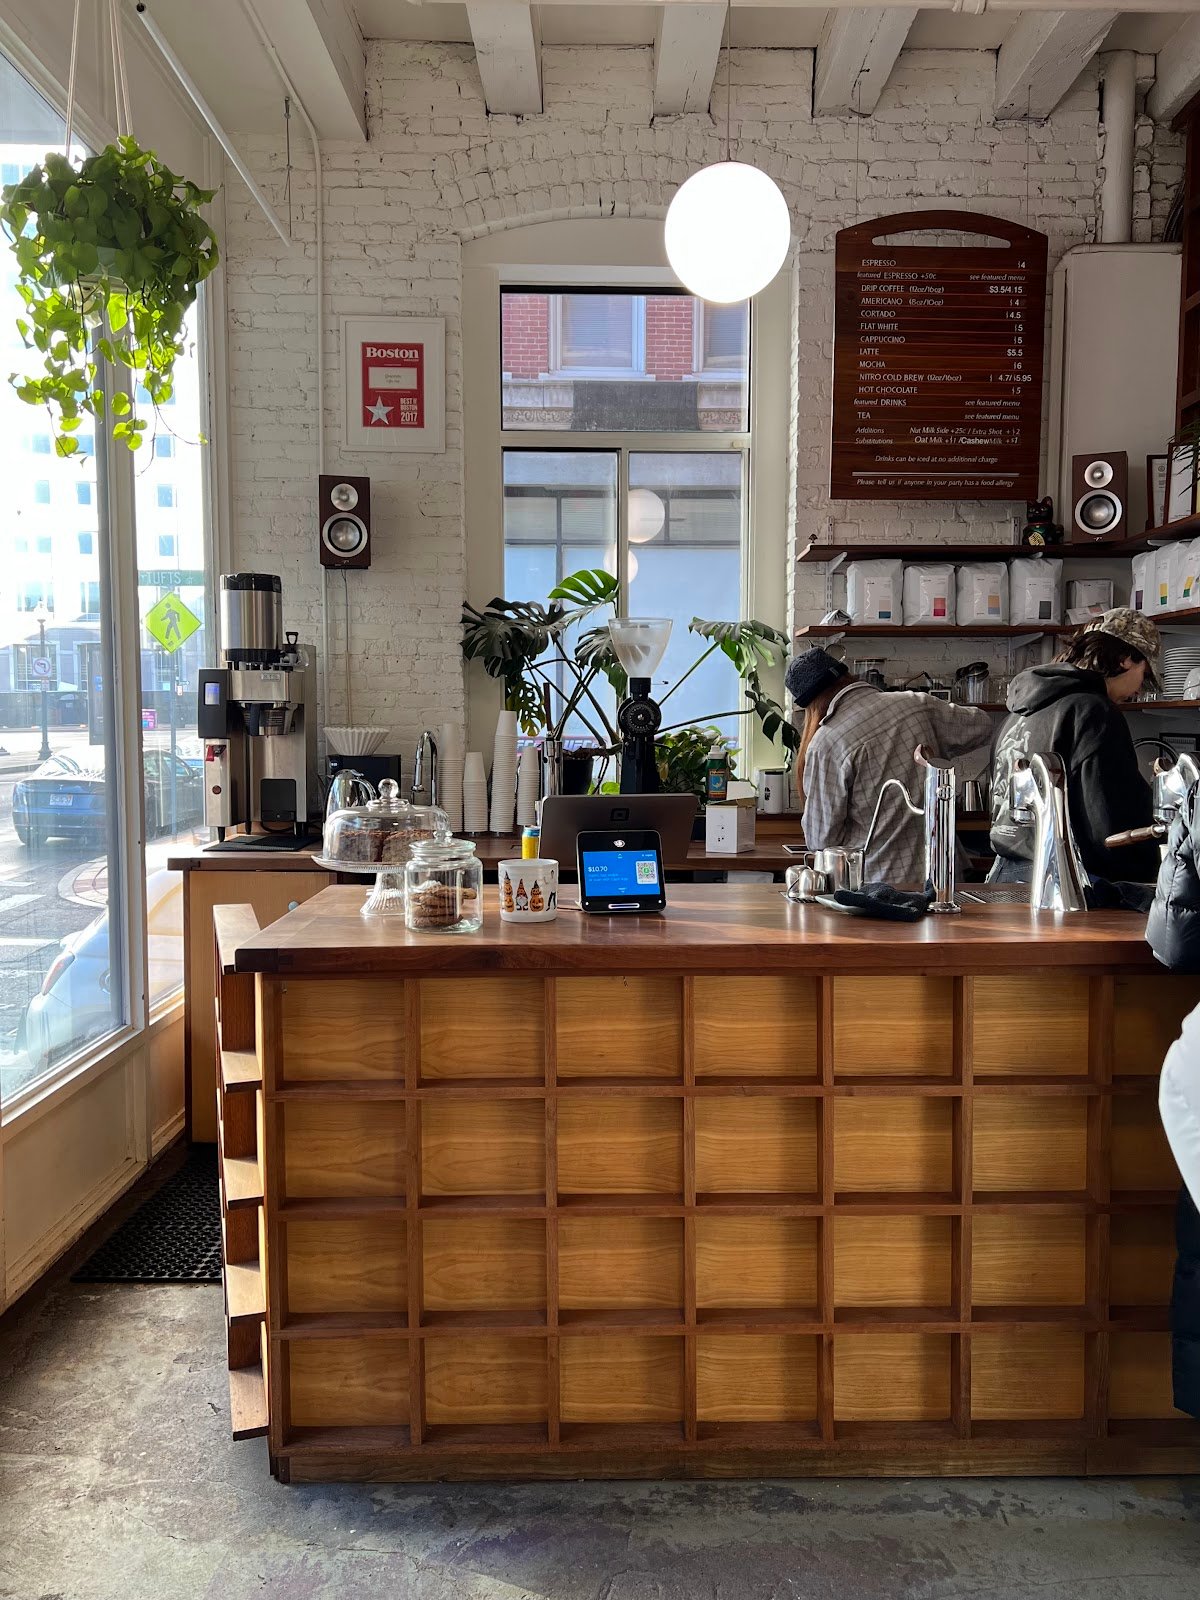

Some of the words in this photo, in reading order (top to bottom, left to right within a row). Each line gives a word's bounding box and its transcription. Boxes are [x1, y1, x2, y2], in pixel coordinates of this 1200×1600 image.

[862, 259, 896, 267] ESPRESSO
[857, 271, 882, 279] featured
[883, 272, 918, 280] ESPRESSO
[980, 273, 1007, 281] featured
[861, 284, 878, 292] DRIP
[878, 285, 904, 293] COFFEE
[860, 322, 876, 330] FLAT
[366, 347, 419, 358] Boston
[859, 348, 879, 356] LATTE
[904, 374, 924, 382] BREW
[875, 386, 918, 394] CHOCOLATE
[401, 412, 418, 422] 2017
[914, 436, 928, 444] Oat
[978, 456, 998, 464] charge
[146, 572, 182, 584] TUFTS
[588, 865, 608, 873] $10.70
